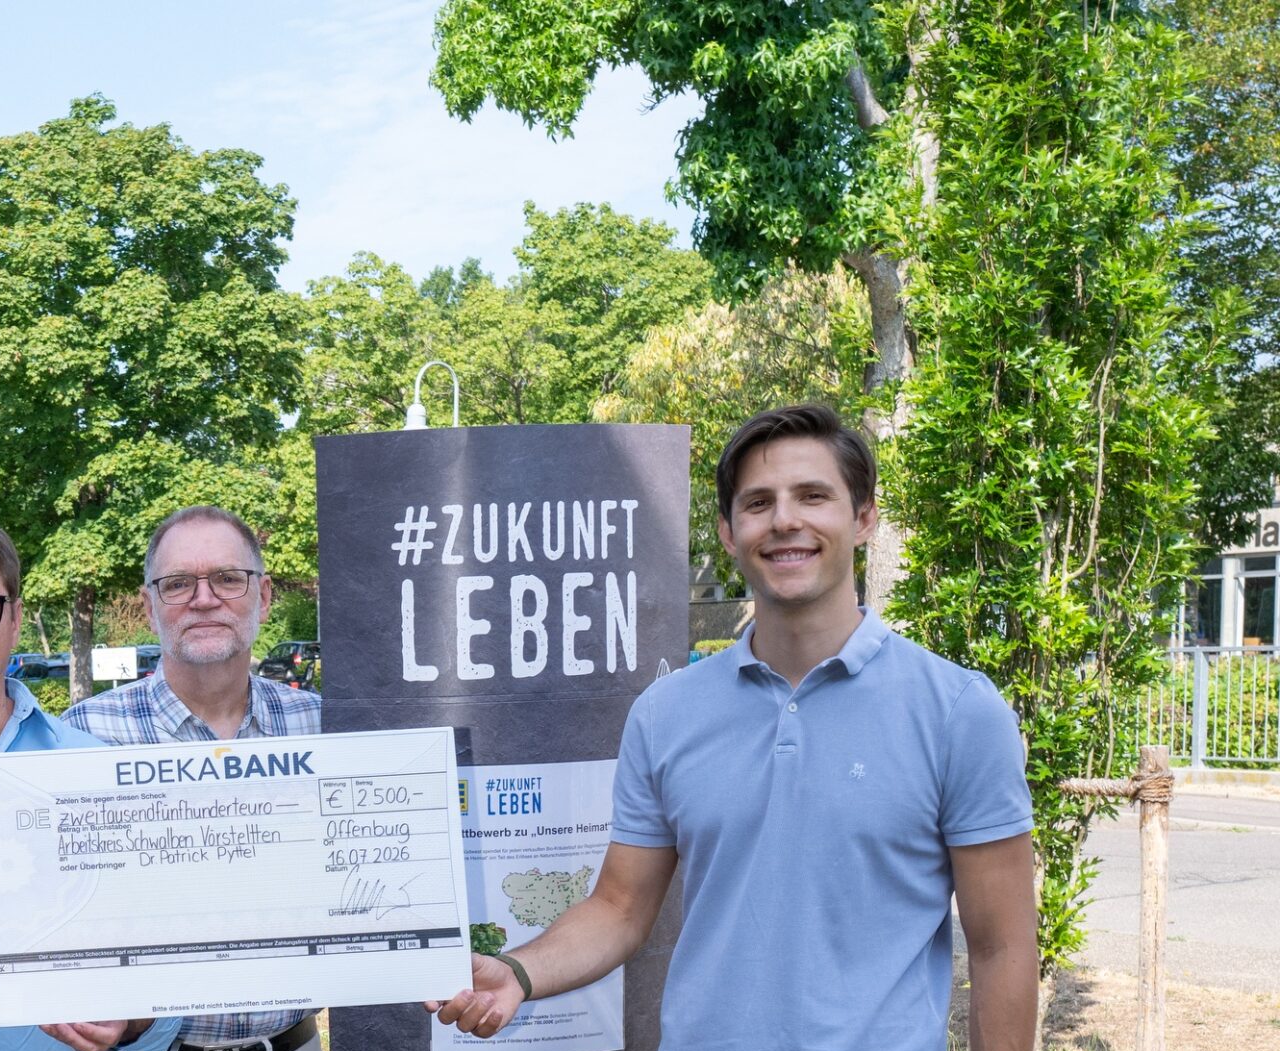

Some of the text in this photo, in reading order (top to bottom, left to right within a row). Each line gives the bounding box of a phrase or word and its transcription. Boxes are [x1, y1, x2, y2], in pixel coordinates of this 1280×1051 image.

[391, 499, 639, 566] #ZUKUNFT
[401, 570, 637, 682] LEBEN
[486, 777, 542, 791] #ZUKUNFT
[56, 797, 79, 805] Zahlen
[93, 796, 115, 804] gegen
[116, 794, 139, 802] diesen
[487, 792, 542, 816] LEBEN
[16, 808, 51, 830] DE
[57, 825, 81, 834] Betrag
[90, 823, 131, 831] Buchstaben
[126, 826, 194, 852] Schwalben
[327, 819, 410, 843] Offenburg
[461, 827, 511, 838] ttbewerb
[514, 828, 528, 836] zu
[60, 861, 126, 872] oder Überbringer
[160, 849, 209, 865] Patrick
